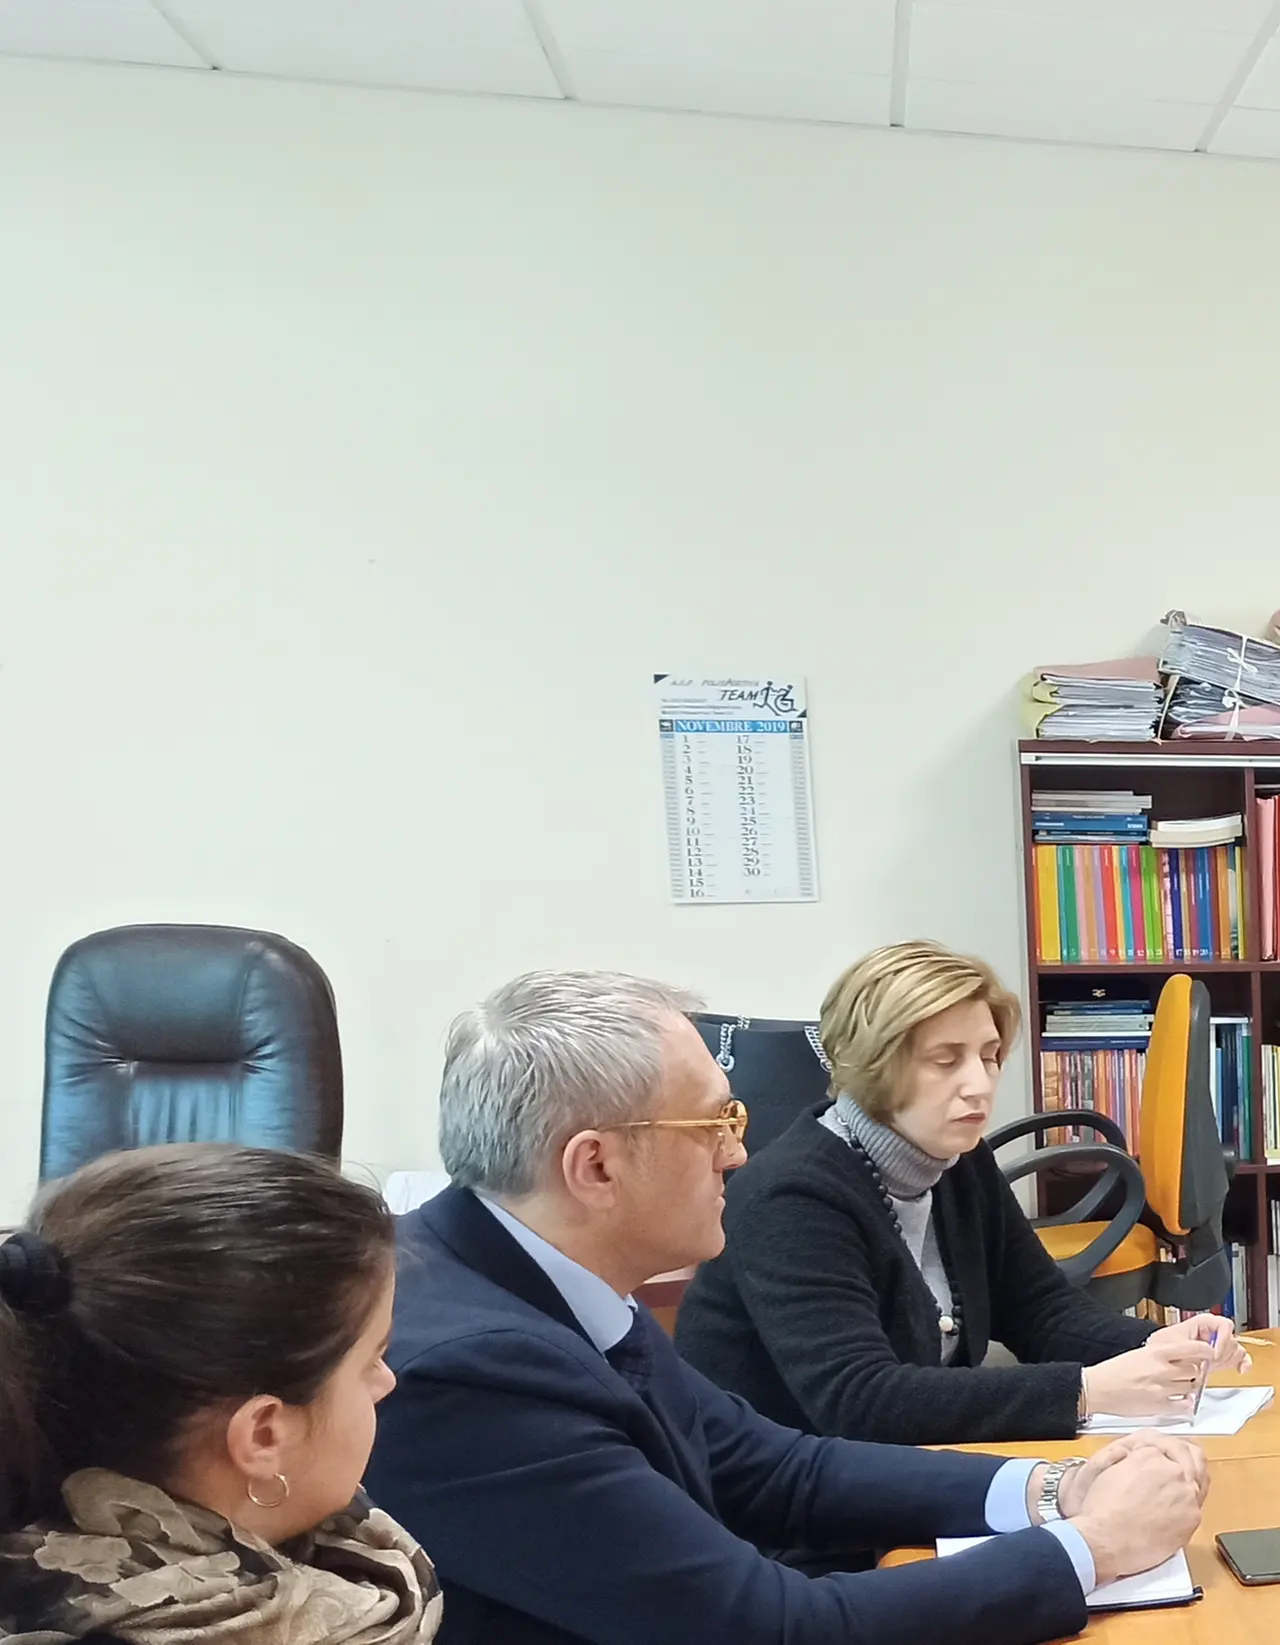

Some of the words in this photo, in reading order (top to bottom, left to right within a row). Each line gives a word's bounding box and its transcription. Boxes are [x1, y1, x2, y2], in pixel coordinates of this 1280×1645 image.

[720, 689, 760, 701] TEAM
[677, 720, 753, 731] NOVEMBRE
[757, 721, 785, 732] 2019
[737, 735, 750, 744] 17
[683, 744, 691, 754] 2
[736, 745, 752, 754] 18
[738, 755, 752, 764] 19
[736, 766, 754, 775] 20
[685, 776, 693, 785] 5
[737, 776, 753, 785] 21
[685, 786, 694, 795] 6
[738, 786, 754, 795] 22
[739, 796, 756, 805] 23
[741, 817, 757, 826] 25
[686, 827, 700, 836] 10
[741, 827, 758, 836] 26
[687, 837, 700, 847] 11
[741, 837, 758, 846] 27
[687, 848, 702, 857] 12
[742, 847, 760, 857] 28
[688, 858, 703, 867] 13
[743, 858, 760, 866] 29
[688, 868, 703, 877] 14
[743, 868, 761, 877] 30
[689, 878, 704, 888] 15
[690, 889, 705, 898] 16
